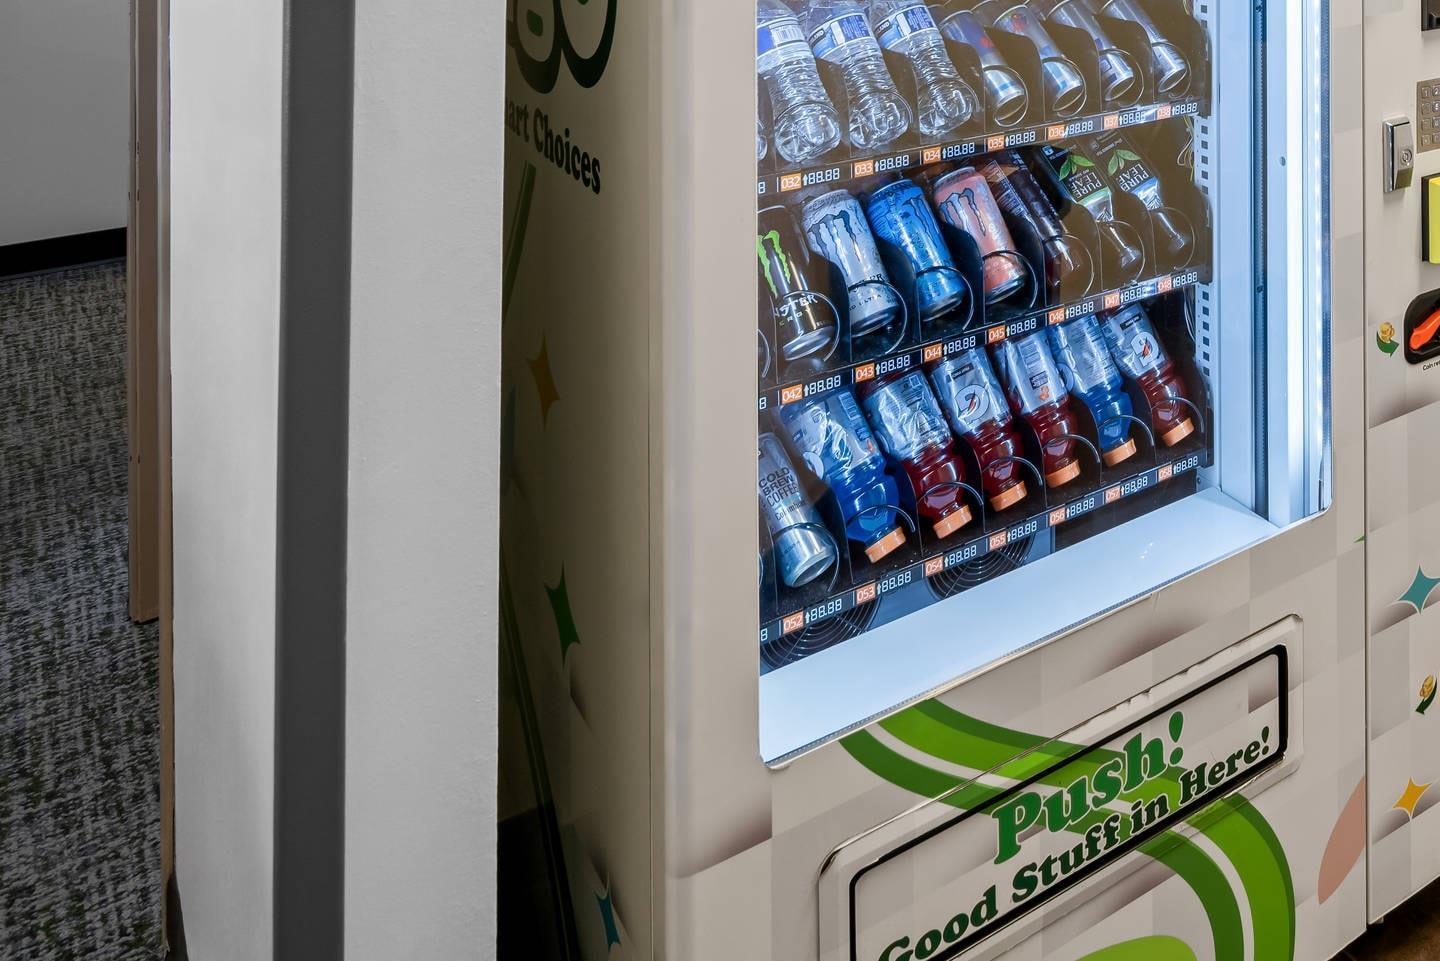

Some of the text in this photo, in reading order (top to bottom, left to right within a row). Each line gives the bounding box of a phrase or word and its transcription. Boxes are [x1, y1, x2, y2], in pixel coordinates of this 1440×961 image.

[1158, 102, 1197, 118] 038 88.88
[1049, 120, 1093, 137] 036 88.88
[1104, 118, 1118, 127] 037
[505, 98, 601, 195] art Choices
[988, 131, 1036, 148] 035 88.88
[924, 142, 975, 160] 034 88.88
[855, 155, 910, 174] 033 88.88
[781, 168, 840, 187] 032 88.88
[1069, 171, 1097, 191] LEAF
[1120, 170, 1149, 192] PURE
[1072, 178, 1103, 199] PURE
[1175, 271, 1198, 286] 88.88
[1105, 296, 1119, 306] 047
[1049, 302, 1094, 322] 046 88.88
[989, 318, 1037, 340] 045 88.88
[925, 336, 976, 359] 044 88.88
[856, 355, 910, 379] 043 88.88
[1422, 362, 1434, 371] Coin
[782, 375, 841, 401] 042 88.88
[759, 467, 790, 488] COLD
[1159, 456, 1198, 479] 058 88.88
[763, 474, 793, 496] BREW
[1106, 489, 1120, 500] 057
[1050, 499, 1095, 522] 056 88.88
[990, 521, 1037, 547] 055 88.88
[926, 545, 977, 571] 054 88.88
[857, 571, 912, 600] 053 88.88
[784, 599, 842, 629] 052 88.88
[992, 711, 1185, 865] Push!
[877, 725, 1271, 961] Good Stuff in Here!
